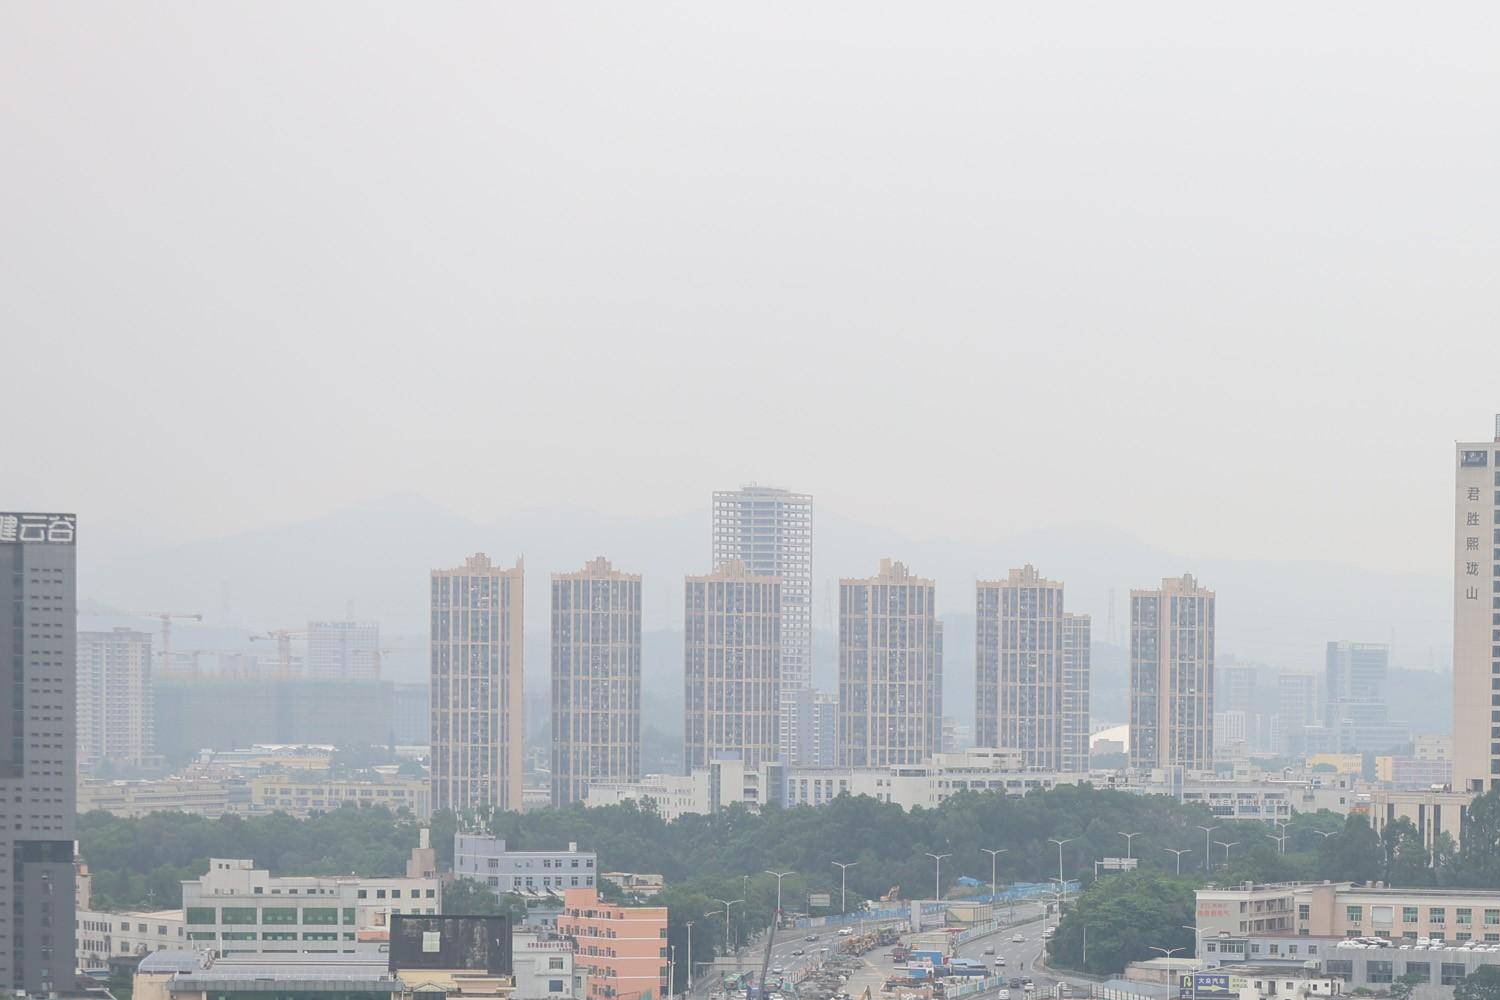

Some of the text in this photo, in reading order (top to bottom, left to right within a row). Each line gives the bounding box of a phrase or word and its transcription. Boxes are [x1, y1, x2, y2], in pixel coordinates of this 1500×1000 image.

[1466, 487, 1480, 600] 君胜熙珑山
